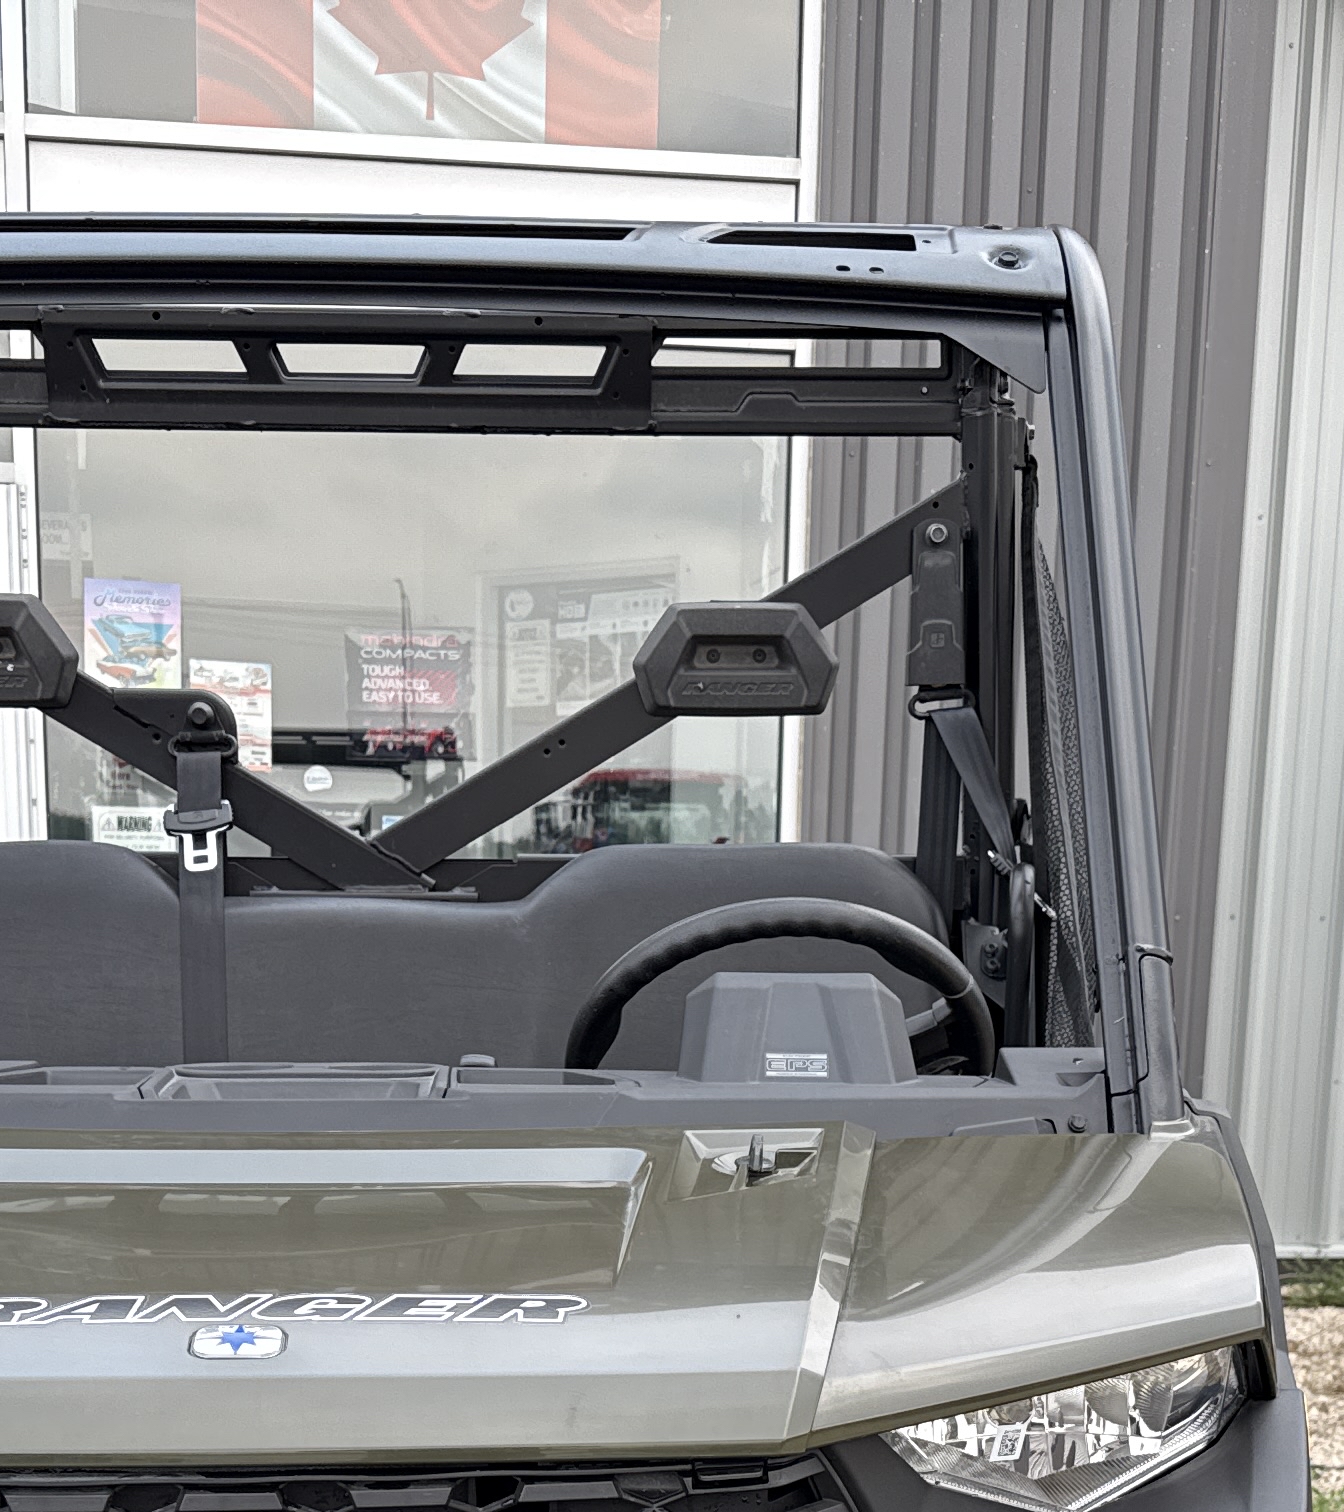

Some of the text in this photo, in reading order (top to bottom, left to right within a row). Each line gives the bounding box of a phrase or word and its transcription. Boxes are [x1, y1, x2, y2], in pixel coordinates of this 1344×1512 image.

[94, 588, 171, 607] Memories
[360, 648, 460, 661] COMPACTS
[682, 681, 794, 695] RANGER
[361, 690, 396, 703] EASY
[397, 690, 413, 703] TO
[117, 815, 152, 832] WARNING
[766, 1058, 828, 1072] EPS
